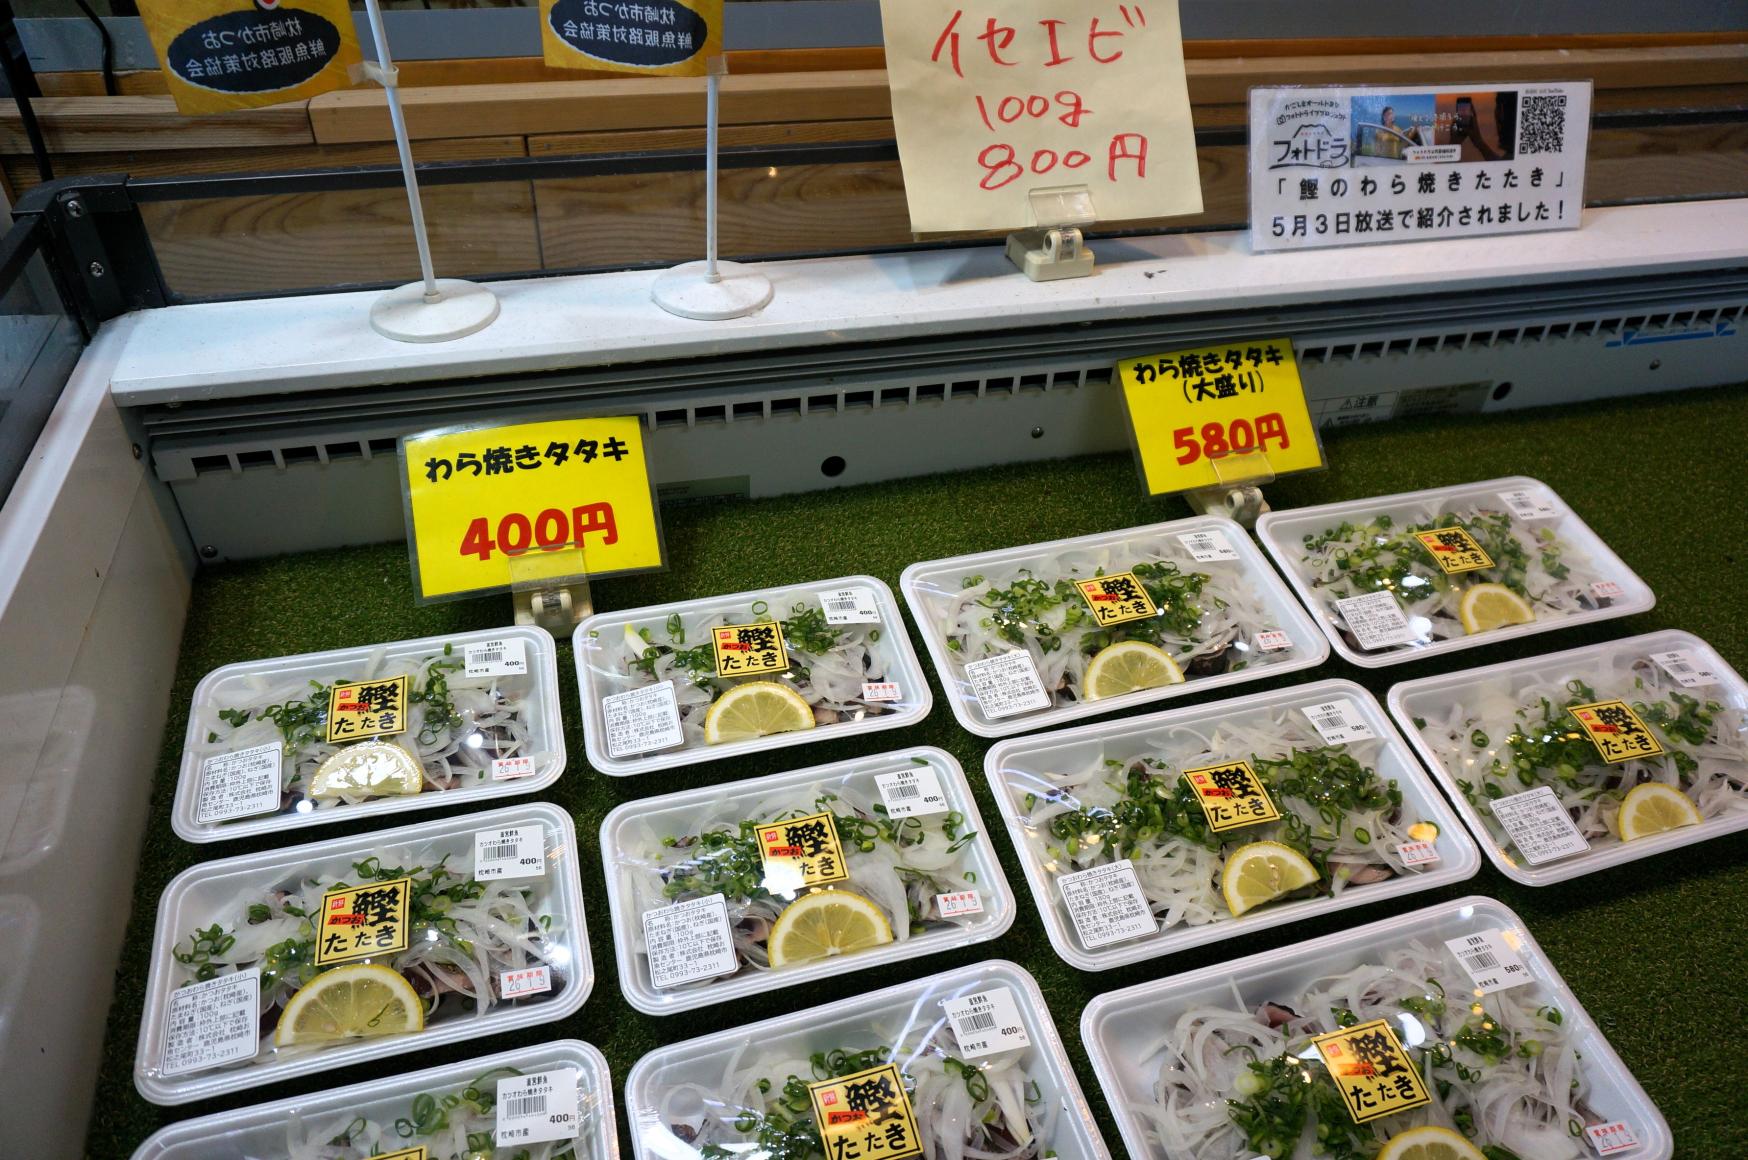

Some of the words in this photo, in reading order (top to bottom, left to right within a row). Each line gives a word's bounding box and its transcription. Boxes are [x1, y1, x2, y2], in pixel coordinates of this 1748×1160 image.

[931, 5, 1146, 78] イセエビ
[975, 91, 1094, 131] 100g
[977, 133, 1148, 190] 800円
[1273, 138, 1349, 163] フォトドラ
[1276, 167, 1566, 201] 「鰹のわら焼きたたき」
[1133, 346, 1284, 385] わら焼きタタキ
[1183, 370, 1264, 404] (大盛り)
[1173, 412, 1290, 466] 580円
[424, 436, 629, 483] わら焼きタタキ
[459, 501, 618, 561] 400円
[1442, 551, 1484, 568] たたき
[1092, 594, 1117, 602] かつお
[1100, 579, 1137, 605] 鰹
[1098, 601, 1148, 620] たたき
[720, 643, 749, 651] かつお
[737, 627, 779, 656] 鰹
[722, 651, 778, 671] たたき
[337, 702, 367, 711] かつお
[358, 682, 400, 715] 鰹
[334, 712, 397, 735] たたき
[1595, 706, 1635, 737] 鰹
[1602, 735, 1652, 757] たたき
[1202, 787, 1232, 798] かつお
[1210, 766, 1261, 800] 鰹
[1210, 796, 1267, 822] たたき
[480, 837, 523, 847] カツオわら焼きタタキ
[769, 846, 801, 857] かつお
[785, 821, 834, 862] 鰹
[478, 868, 503, 876] 枕崎市産
[520, 857, 542, 865] 400円
[352, 885, 400, 929] 鰹
[328, 914, 363, 925] かつお
[324, 926, 397, 956] たたき
[507, 969, 543, 981] 賞味期限
[656, 973, 668, 981] TEL
[670, 962, 719, 977] 0993-73-2311
[952, 1004, 995, 1018] カツオわら焼きタタキ
[1001, 1026, 1023, 1036] 400円
[166, 1060, 178, 1069] TEL
[181, 1047, 238, 1065] 0993-73-2311
[964, 1041, 988, 1052] 枕崎市産
[1349, 1028, 1409, 1082] 鰹
[502, 1086, 553, 1100] カツオわら焼きタタキ
[844, 1074, 905, 1133] 鰹
[1350, 1076, 1417, 1111] たたき
[549, 1113, 576, 1124] 400円
[828, 1110, 865, 1124] かつお
[501, 1128, 529, 1139] 枕崎市産
[833, 1126, 908, 1160] たたき
